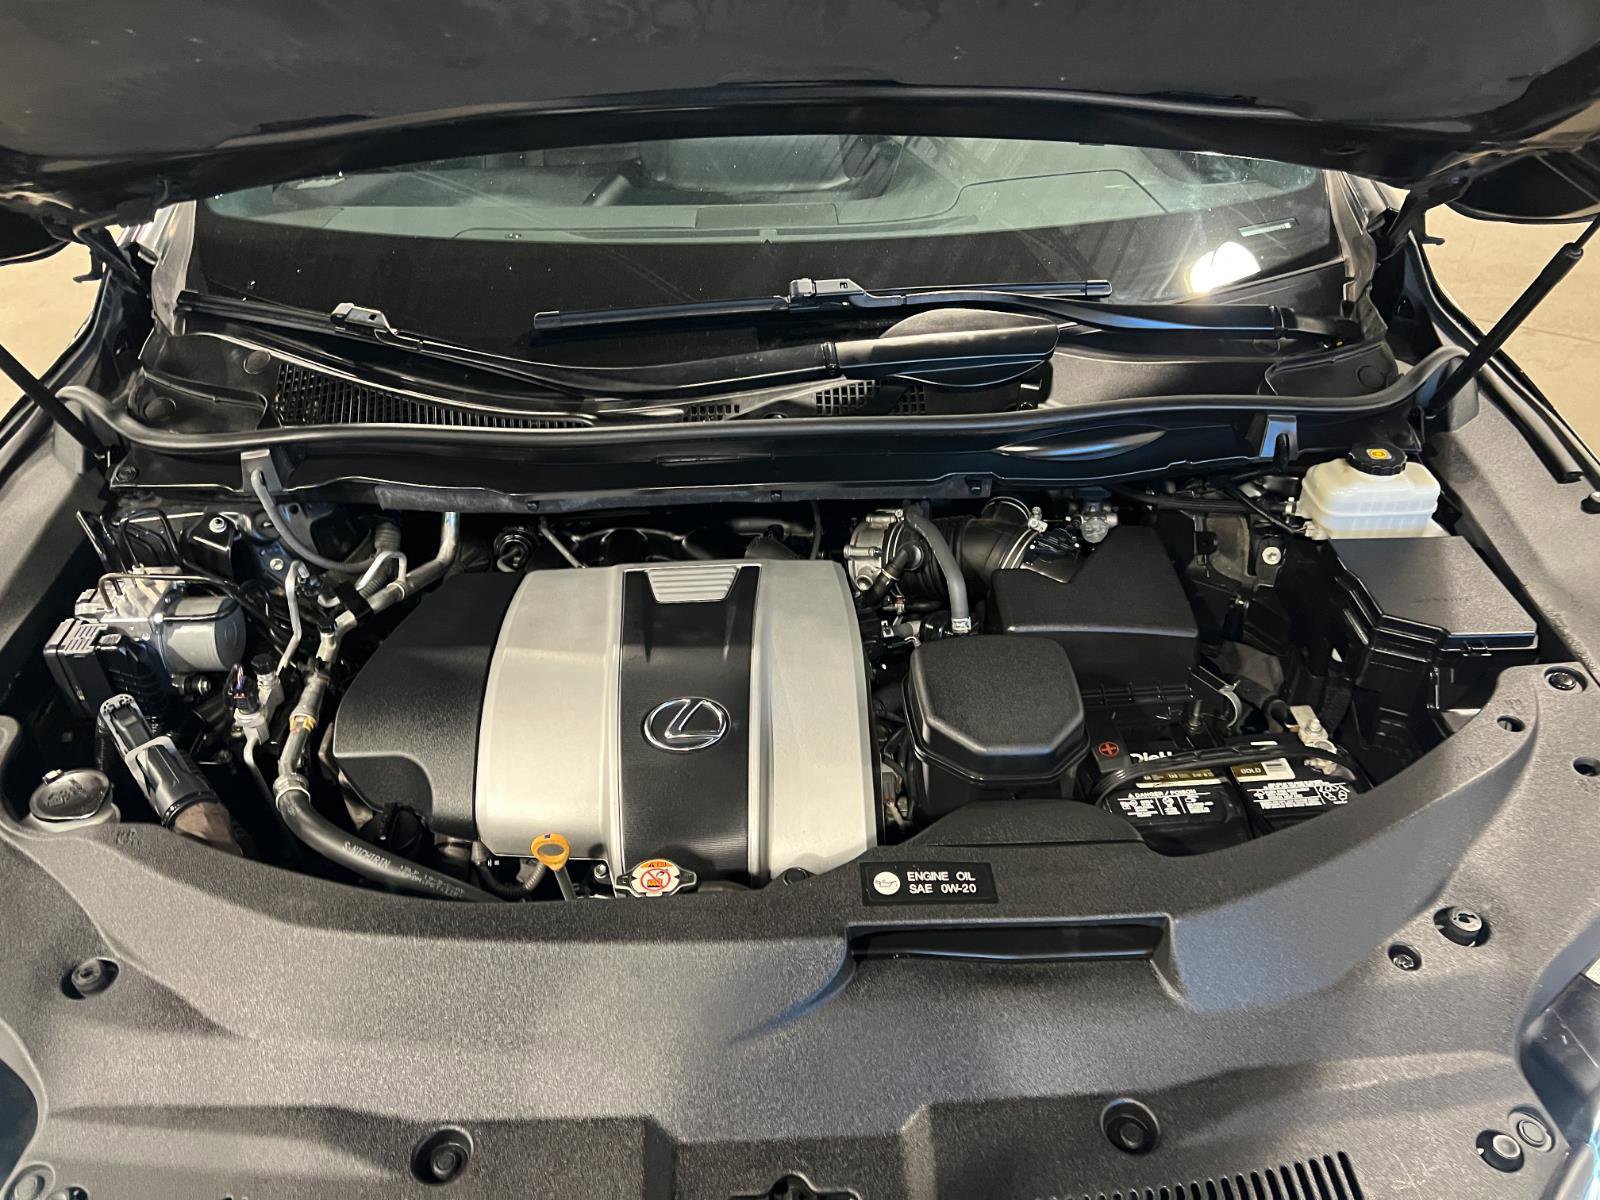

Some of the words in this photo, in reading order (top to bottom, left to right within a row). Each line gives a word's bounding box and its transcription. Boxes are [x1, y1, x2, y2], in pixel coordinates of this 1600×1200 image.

[1240, 767, 1262, 775] GOLD
[1135, 790, 1164, 798] DANGER
[906, 871, 949, 881] ENGINE
[955, 871, 976, 881] OIL
[908, 883, 933, 894] SAE
[940, 883, 977, 894] 0W-20
